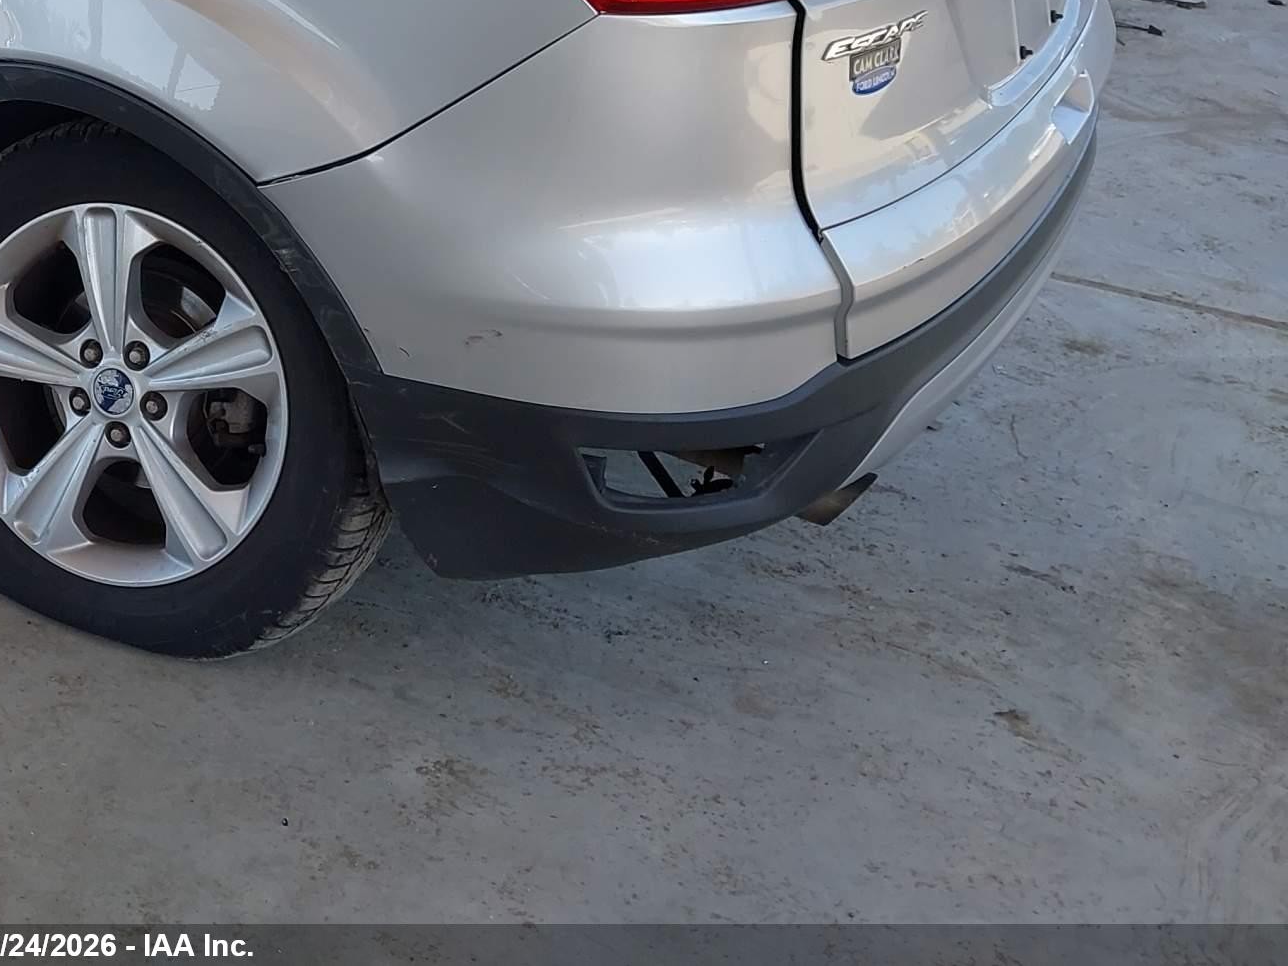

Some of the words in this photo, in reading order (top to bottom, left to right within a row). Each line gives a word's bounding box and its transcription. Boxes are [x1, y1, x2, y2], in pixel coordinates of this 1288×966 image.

[823, 10, 928, 61] ESCAPE
[854, 56, 873, 75] CAM
[874, 45, 899, 67] CLARK
